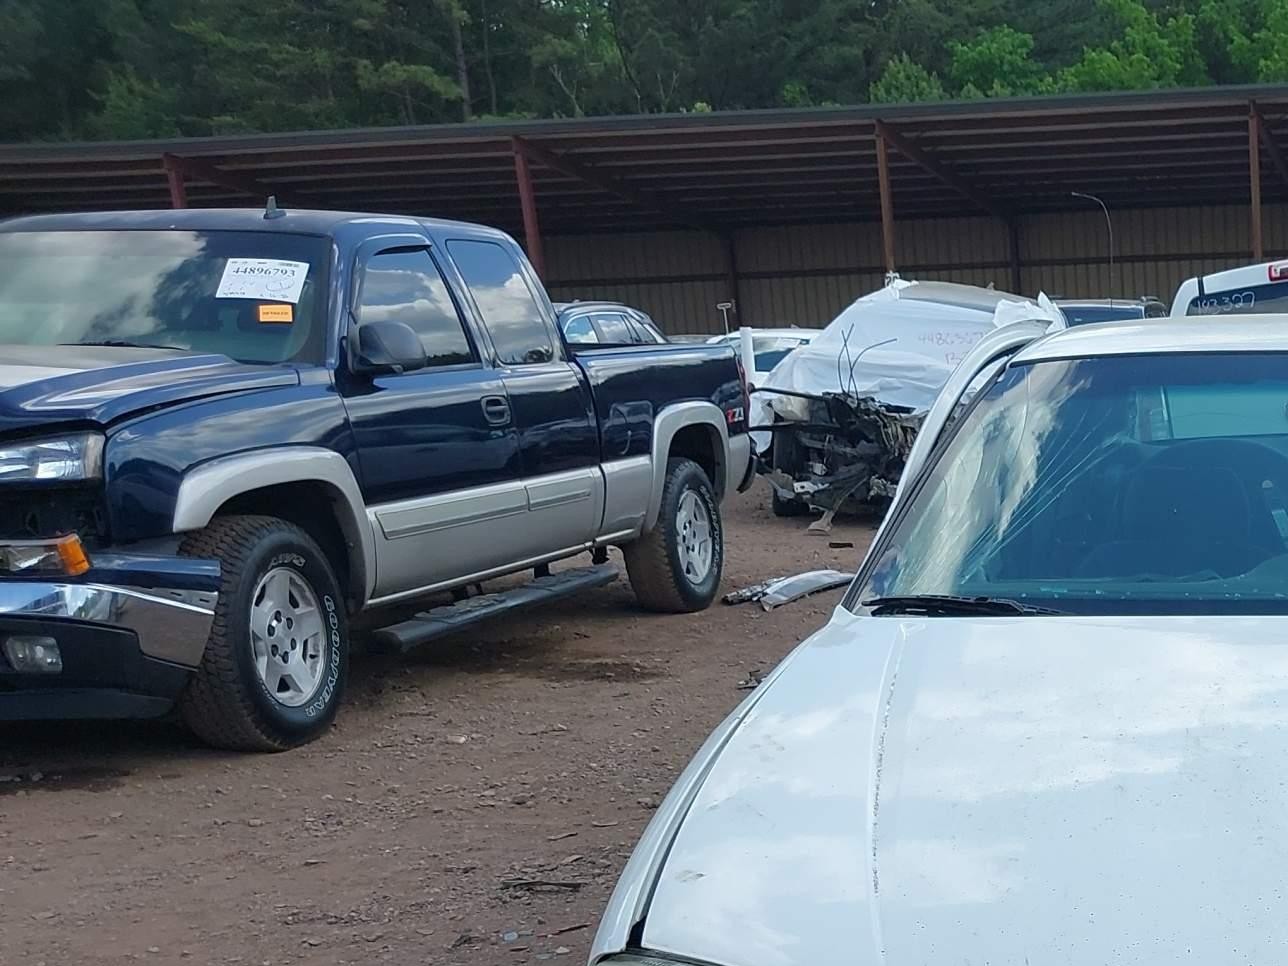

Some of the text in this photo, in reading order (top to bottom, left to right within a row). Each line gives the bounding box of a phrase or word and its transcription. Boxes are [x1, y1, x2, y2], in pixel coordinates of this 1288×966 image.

[232, 266, 296, 278] 44896793
[726, 407, 744, 422] Z71
[305, 595, 340, 717] GOODYEAR
